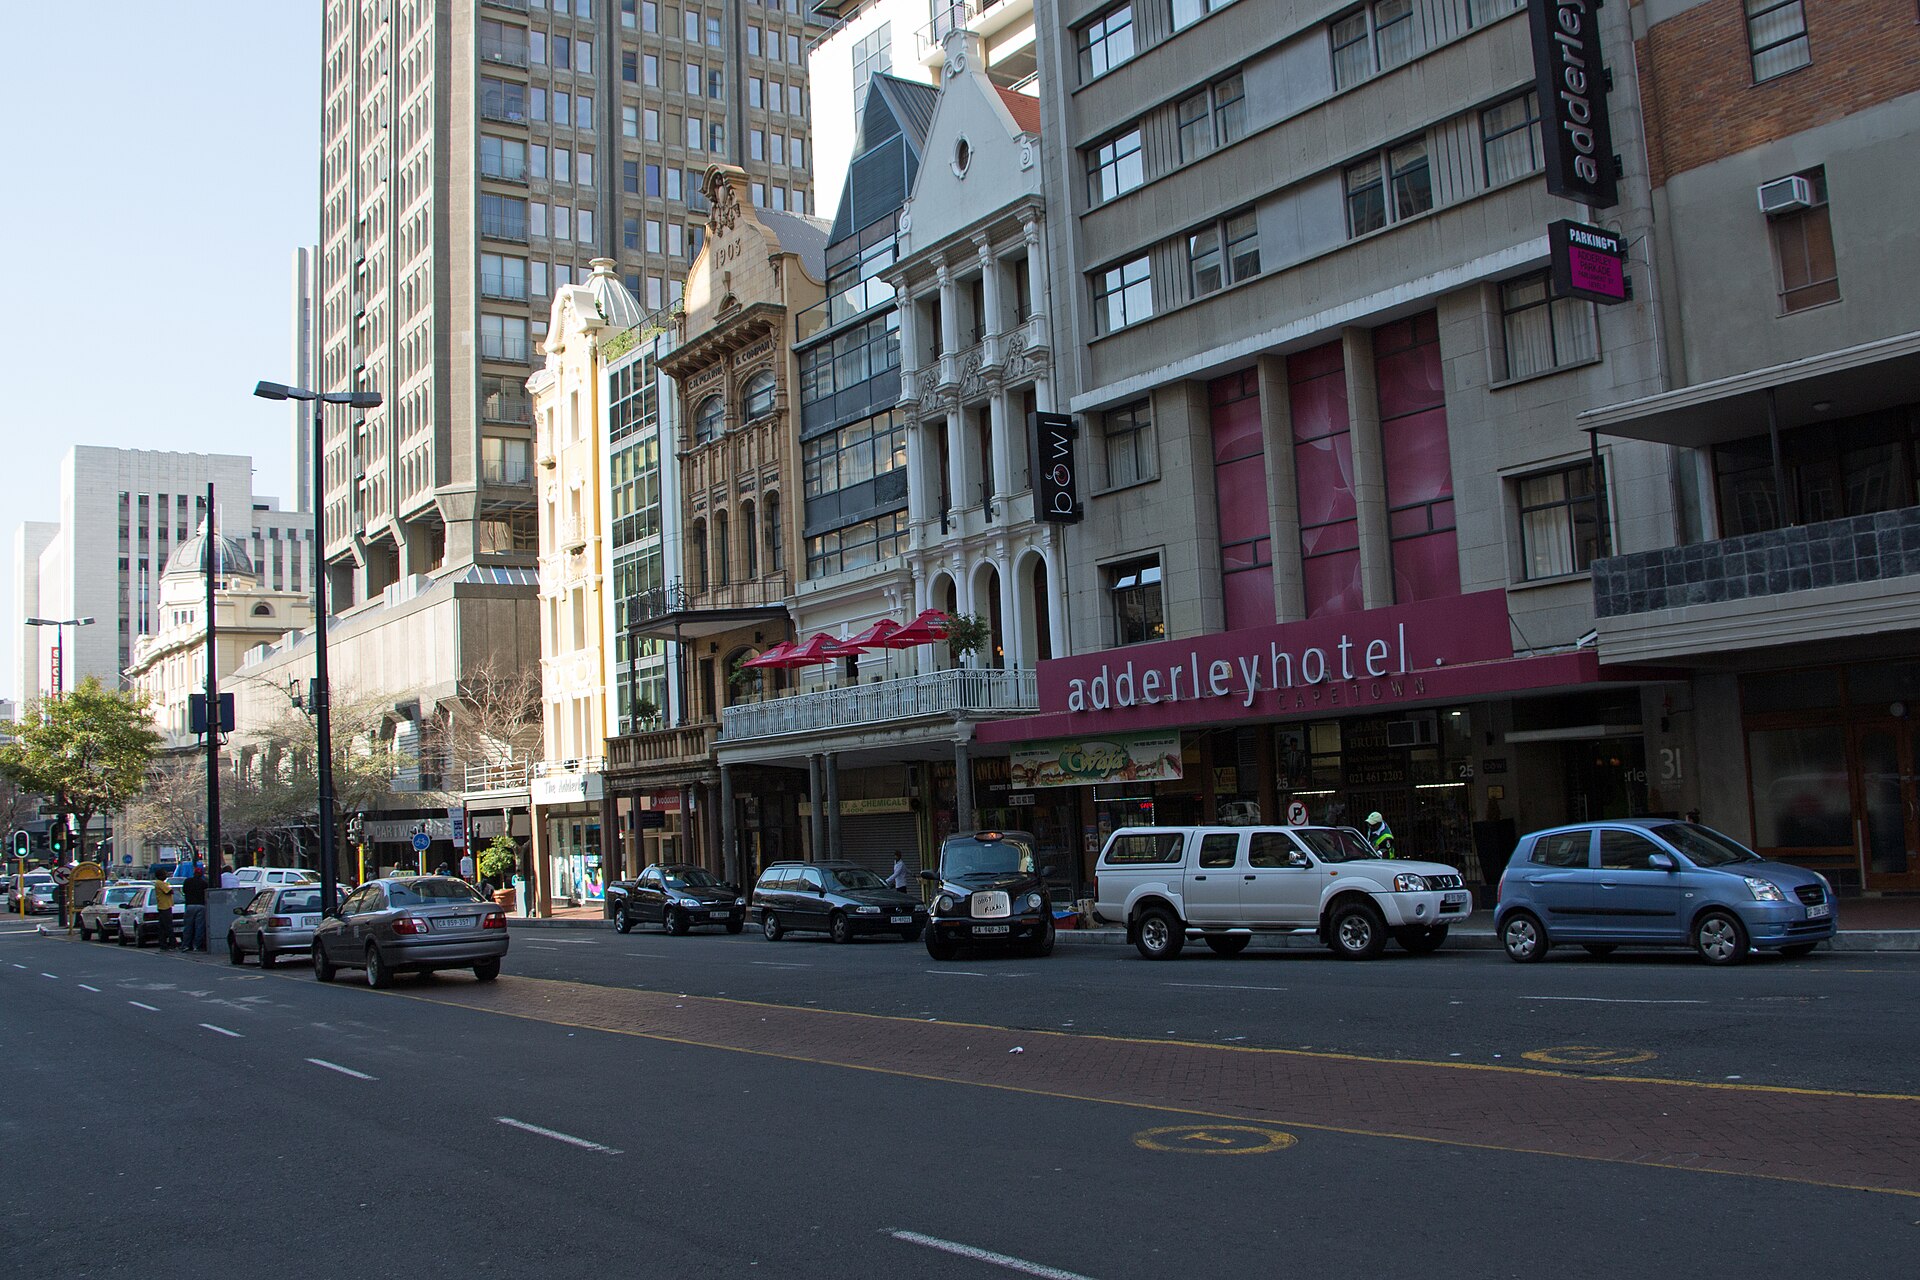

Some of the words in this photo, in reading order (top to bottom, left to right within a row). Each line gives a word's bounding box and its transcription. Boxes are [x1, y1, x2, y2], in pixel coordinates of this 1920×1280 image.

[1569, 228, 1607, 250] PARKING
[713, 237, 741, 270] 1903
[1044, 421, 1072, 514] bowl
[1068, 622, 1405, 713] adderleyhotel
[1278, 686, 1340, 711] CAPE
[1352, 677, 1424, 702] TOWN
[1459, 765, 1473, 778] 25
[1660, 748, 1682, 779] 31
[545, 781, 556, 795] The
[1277, 778, 1289, 790] 25
[657, 796, 679, 805] vodacom
[861, 798, 908, 808] CHEMICALS
